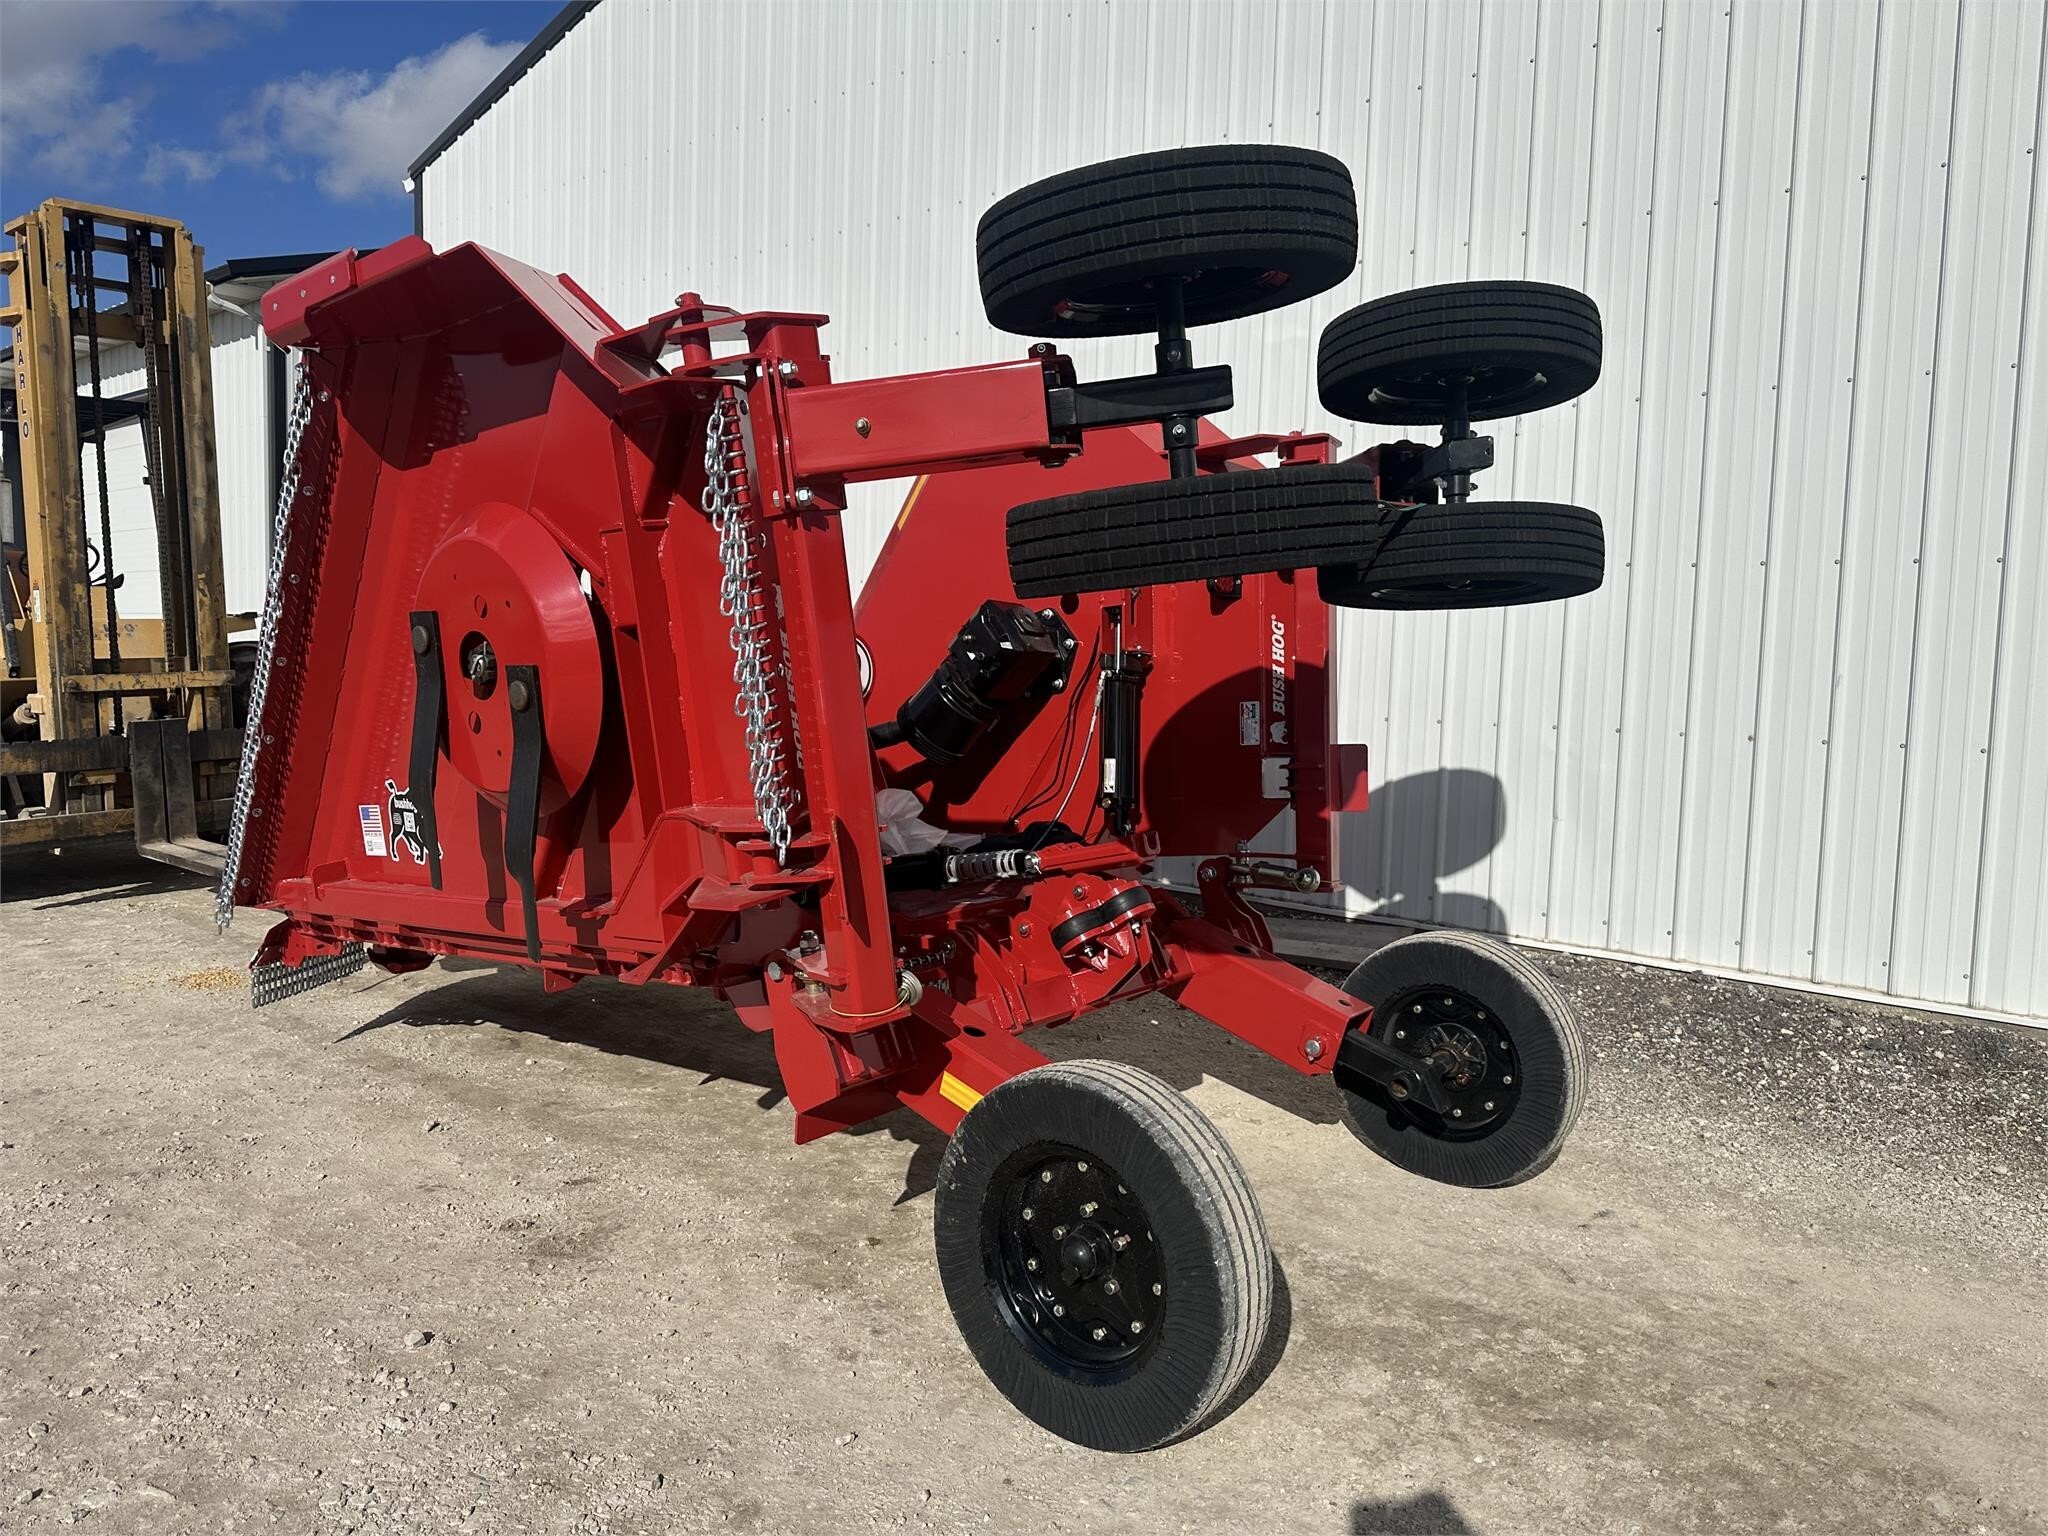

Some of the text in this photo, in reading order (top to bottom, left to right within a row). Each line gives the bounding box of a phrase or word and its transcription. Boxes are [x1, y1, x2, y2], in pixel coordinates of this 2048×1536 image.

[16, 326, 29, 438] HARLO
[780, 629, 805, 770] BUSH HOG
[1272, 620, 1285, 716] BUSH HOG
